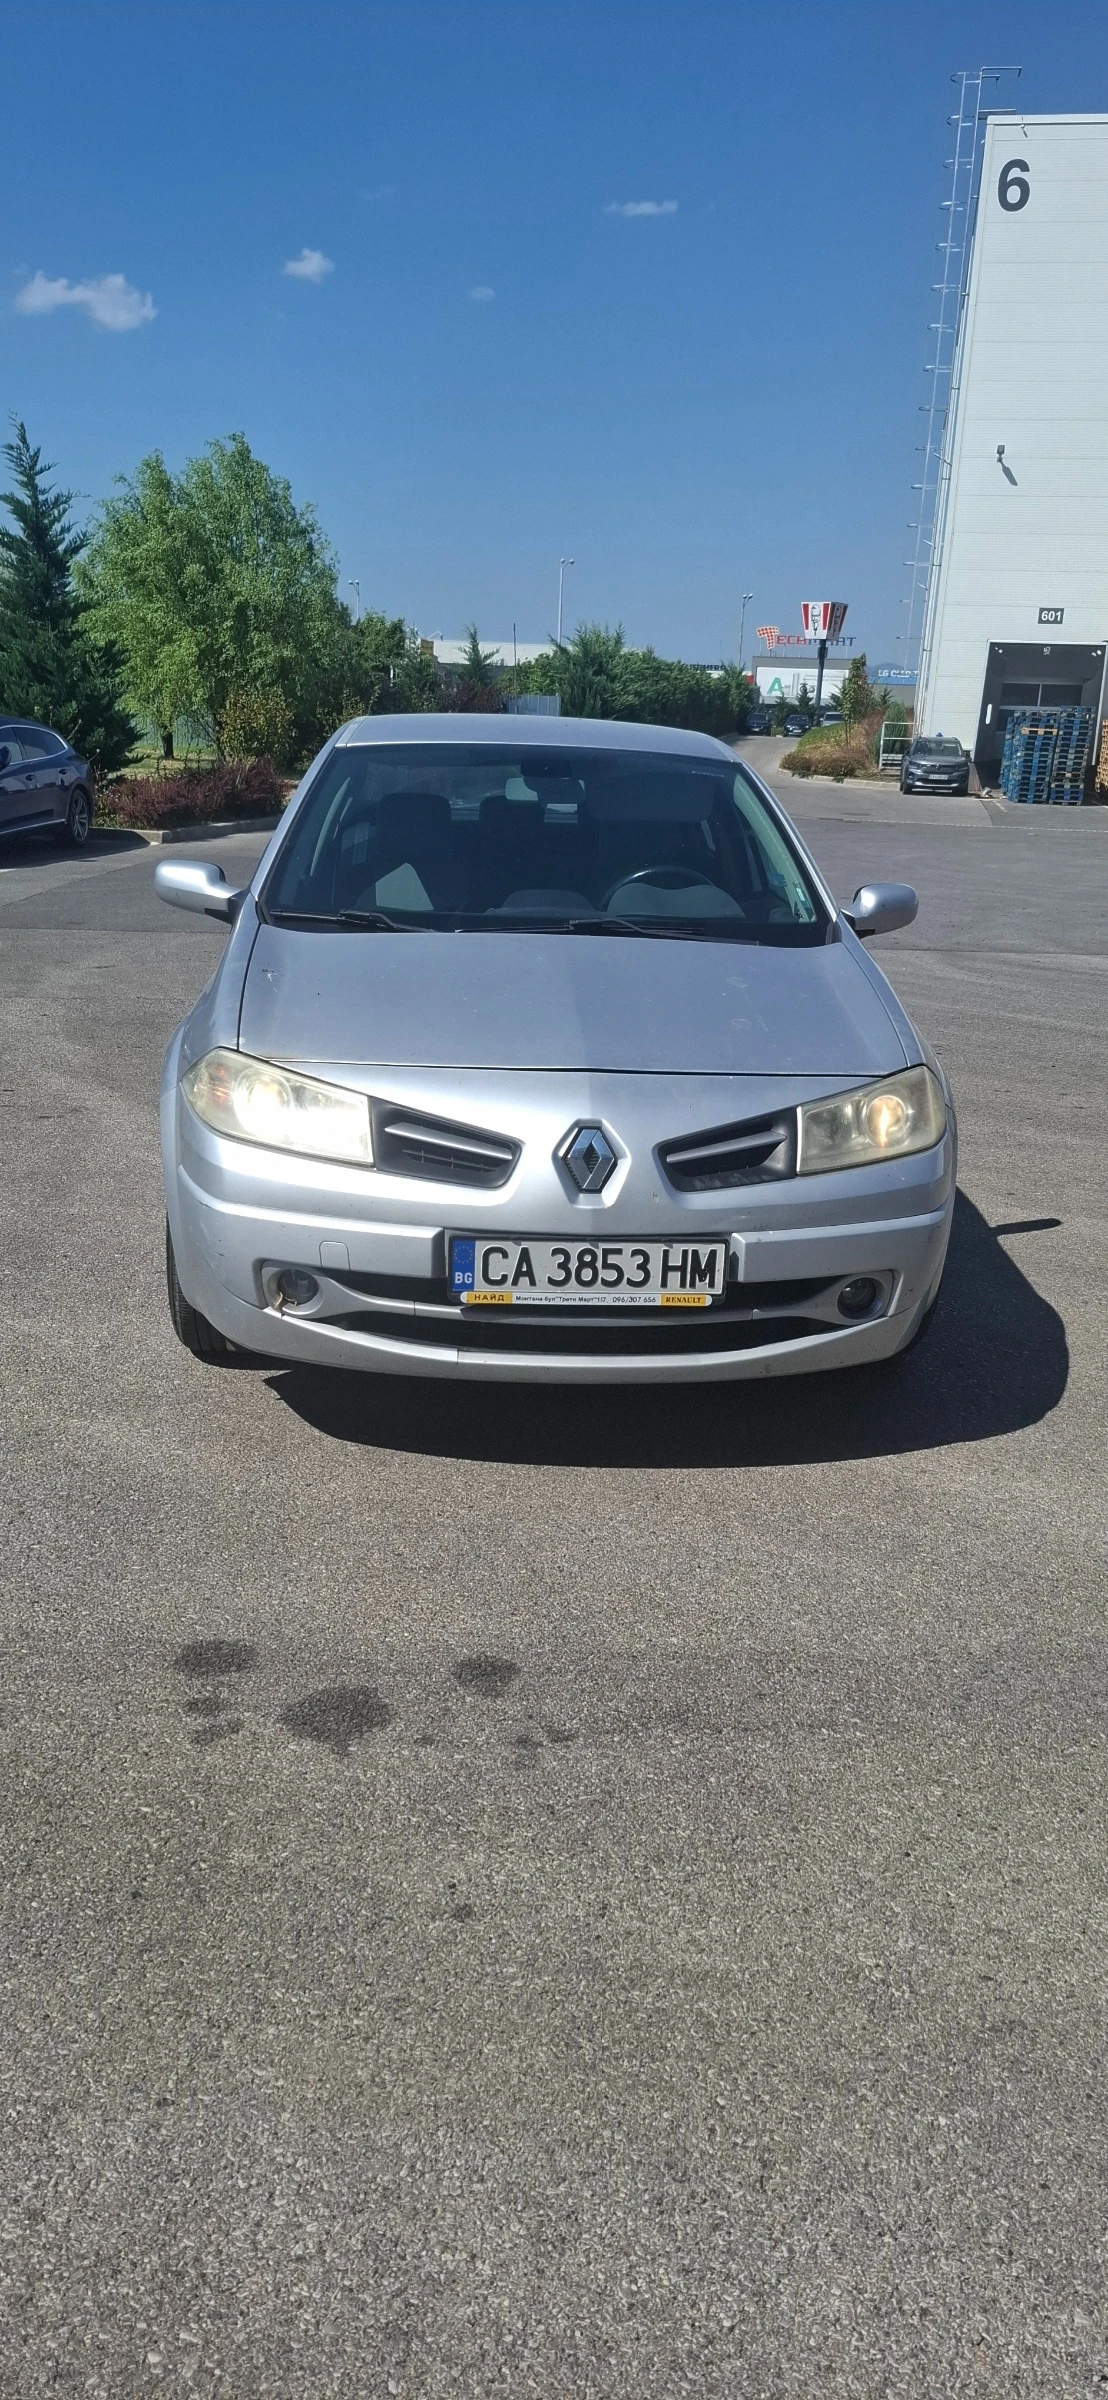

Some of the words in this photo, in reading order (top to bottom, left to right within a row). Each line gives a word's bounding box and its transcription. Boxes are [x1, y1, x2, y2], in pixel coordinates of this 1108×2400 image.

[998, 158, 1031, 213] 6
[1041, 610, 1061, 621] 601
[878, 669, 889, 677] LG
[481, 1245, 537, 1287] CA
[546, 1246, 652, 1289] 3853
[660, 1247, 718, 1290] HM
[454, 1271, 473, 1284] BG
[474, 1292, 505, 1301] НАЙД
[643, 1296, 657, 1304] 656
[665, 1296, 702, 1304] RENAULT
